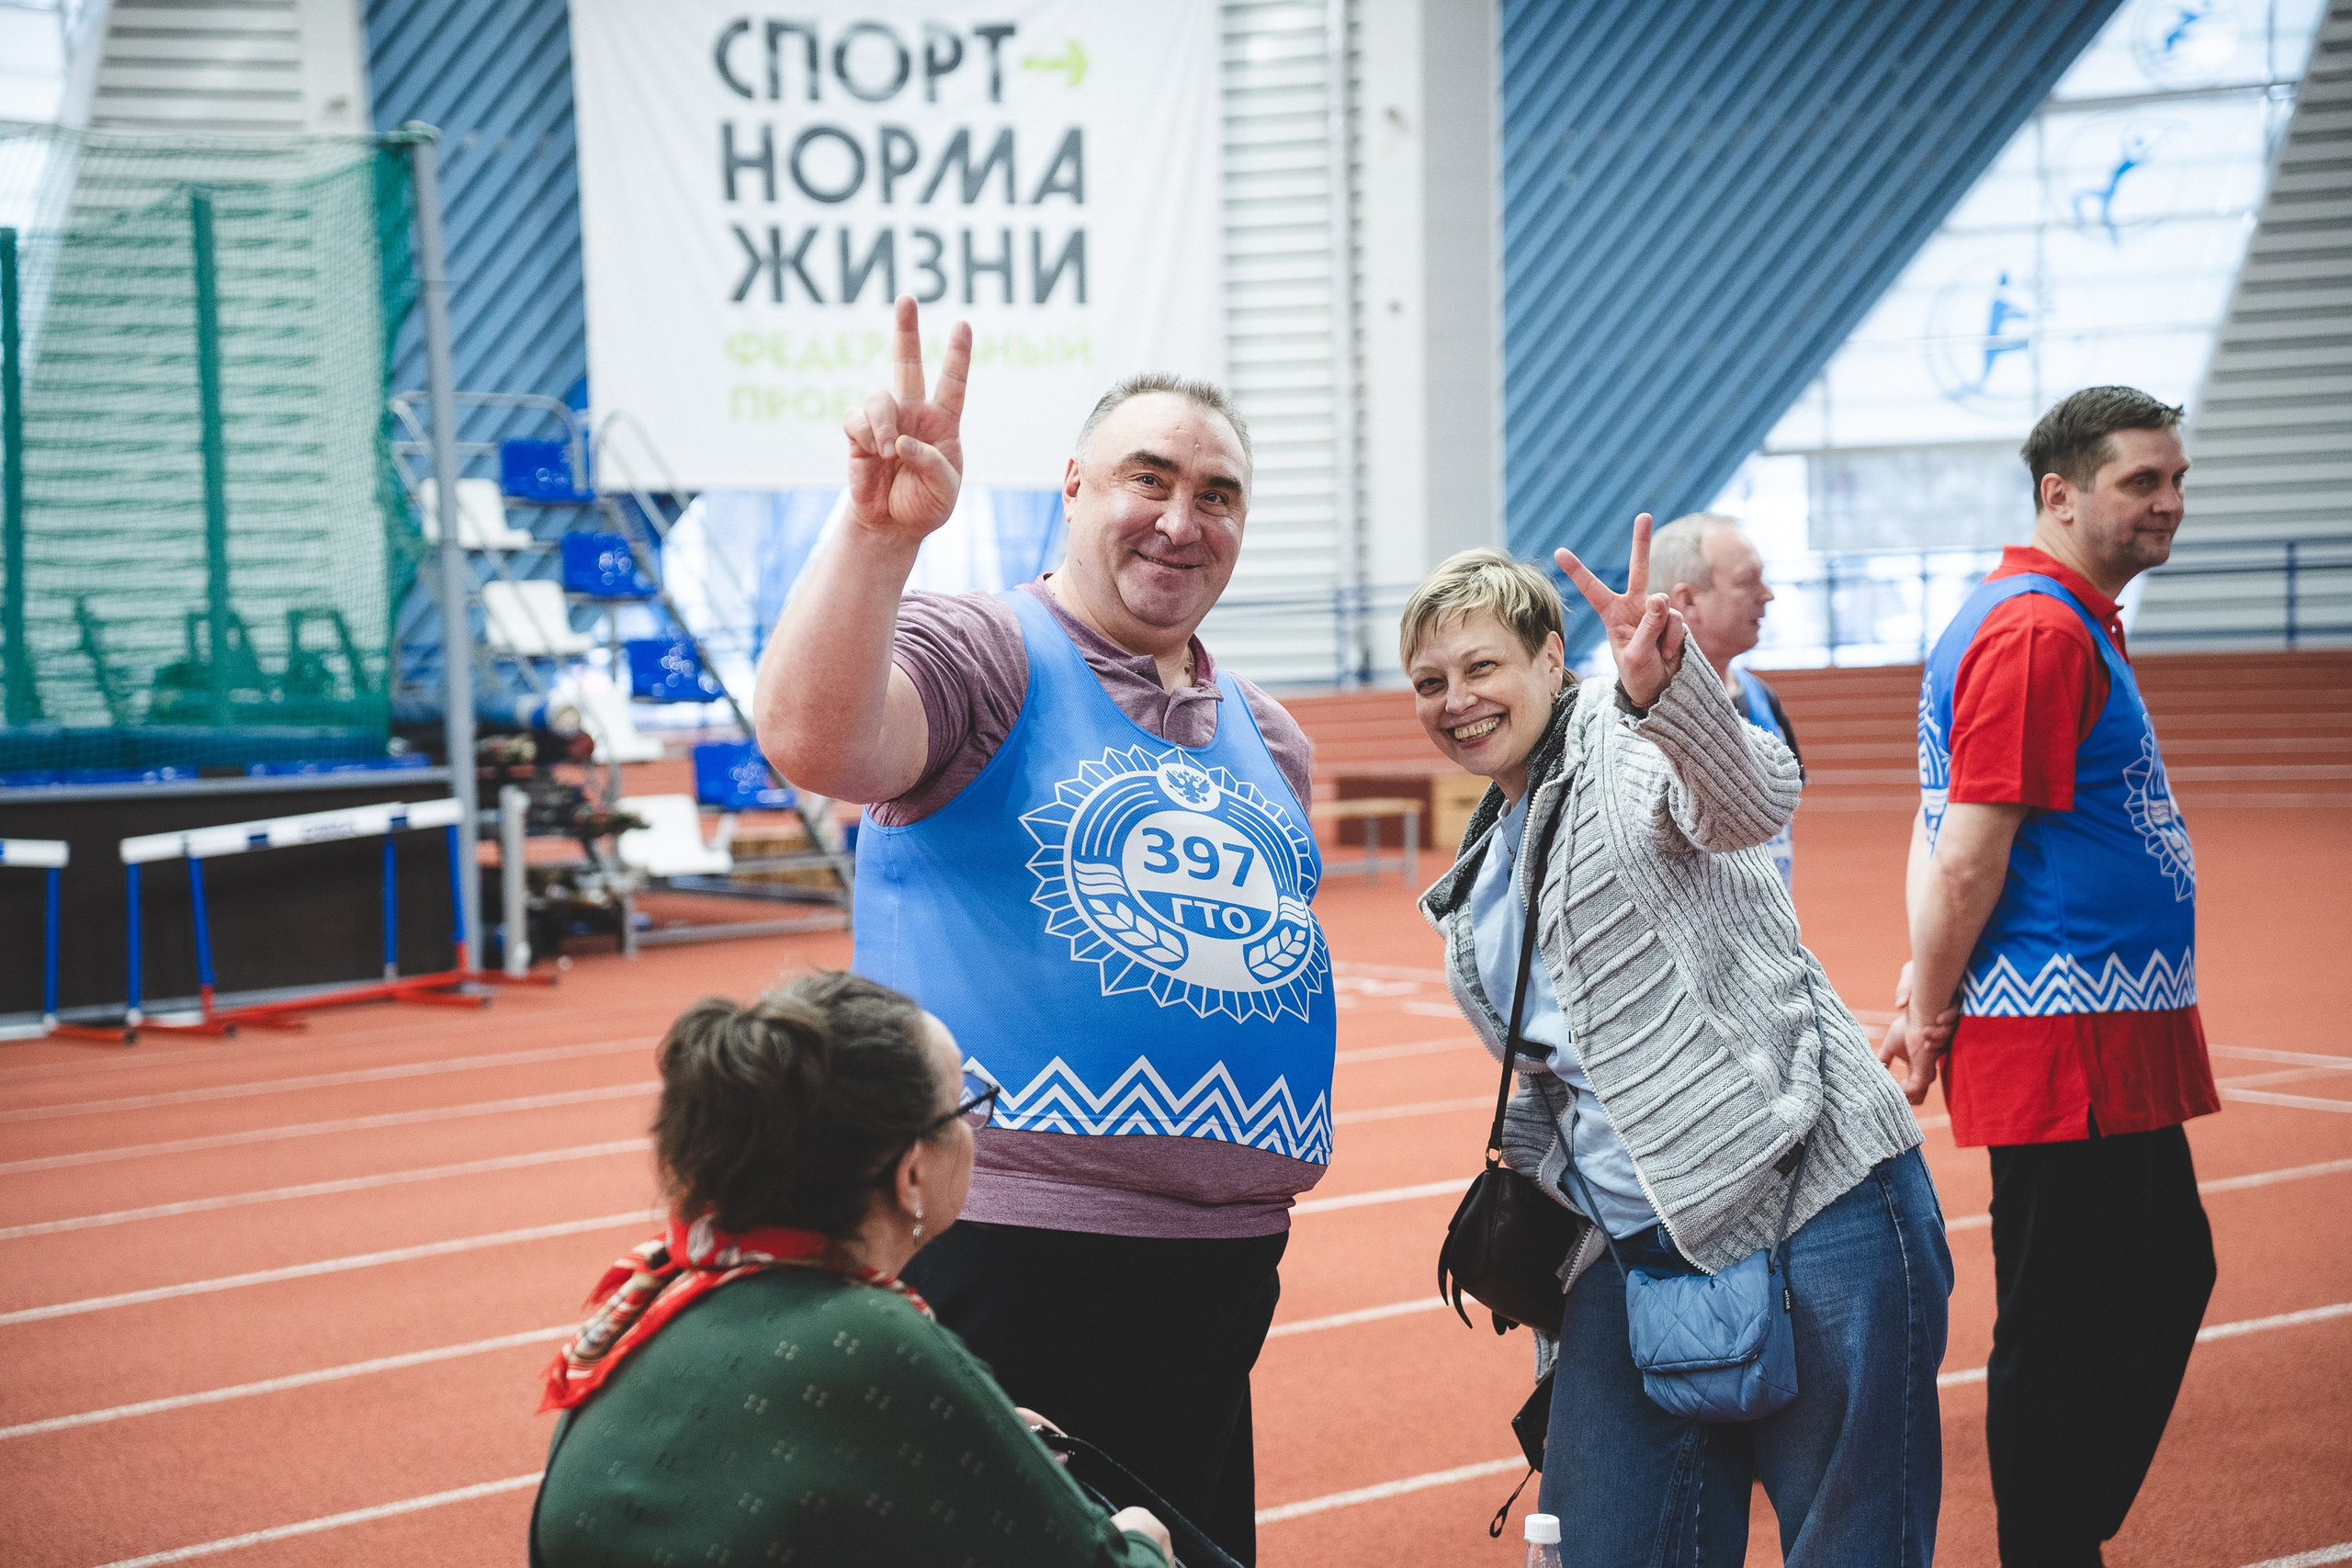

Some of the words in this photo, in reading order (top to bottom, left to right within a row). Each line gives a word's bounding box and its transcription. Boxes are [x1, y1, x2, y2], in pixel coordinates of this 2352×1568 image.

[713, 16, 1017, 103] СПОРТ
[719, 121, 1087, 206] НОРМА
[729, 225, 1089, 305] ЖИЗНИ
[1142, 827, 1255, 887] 397
[1170, 898, 1252, 934] ГТО
